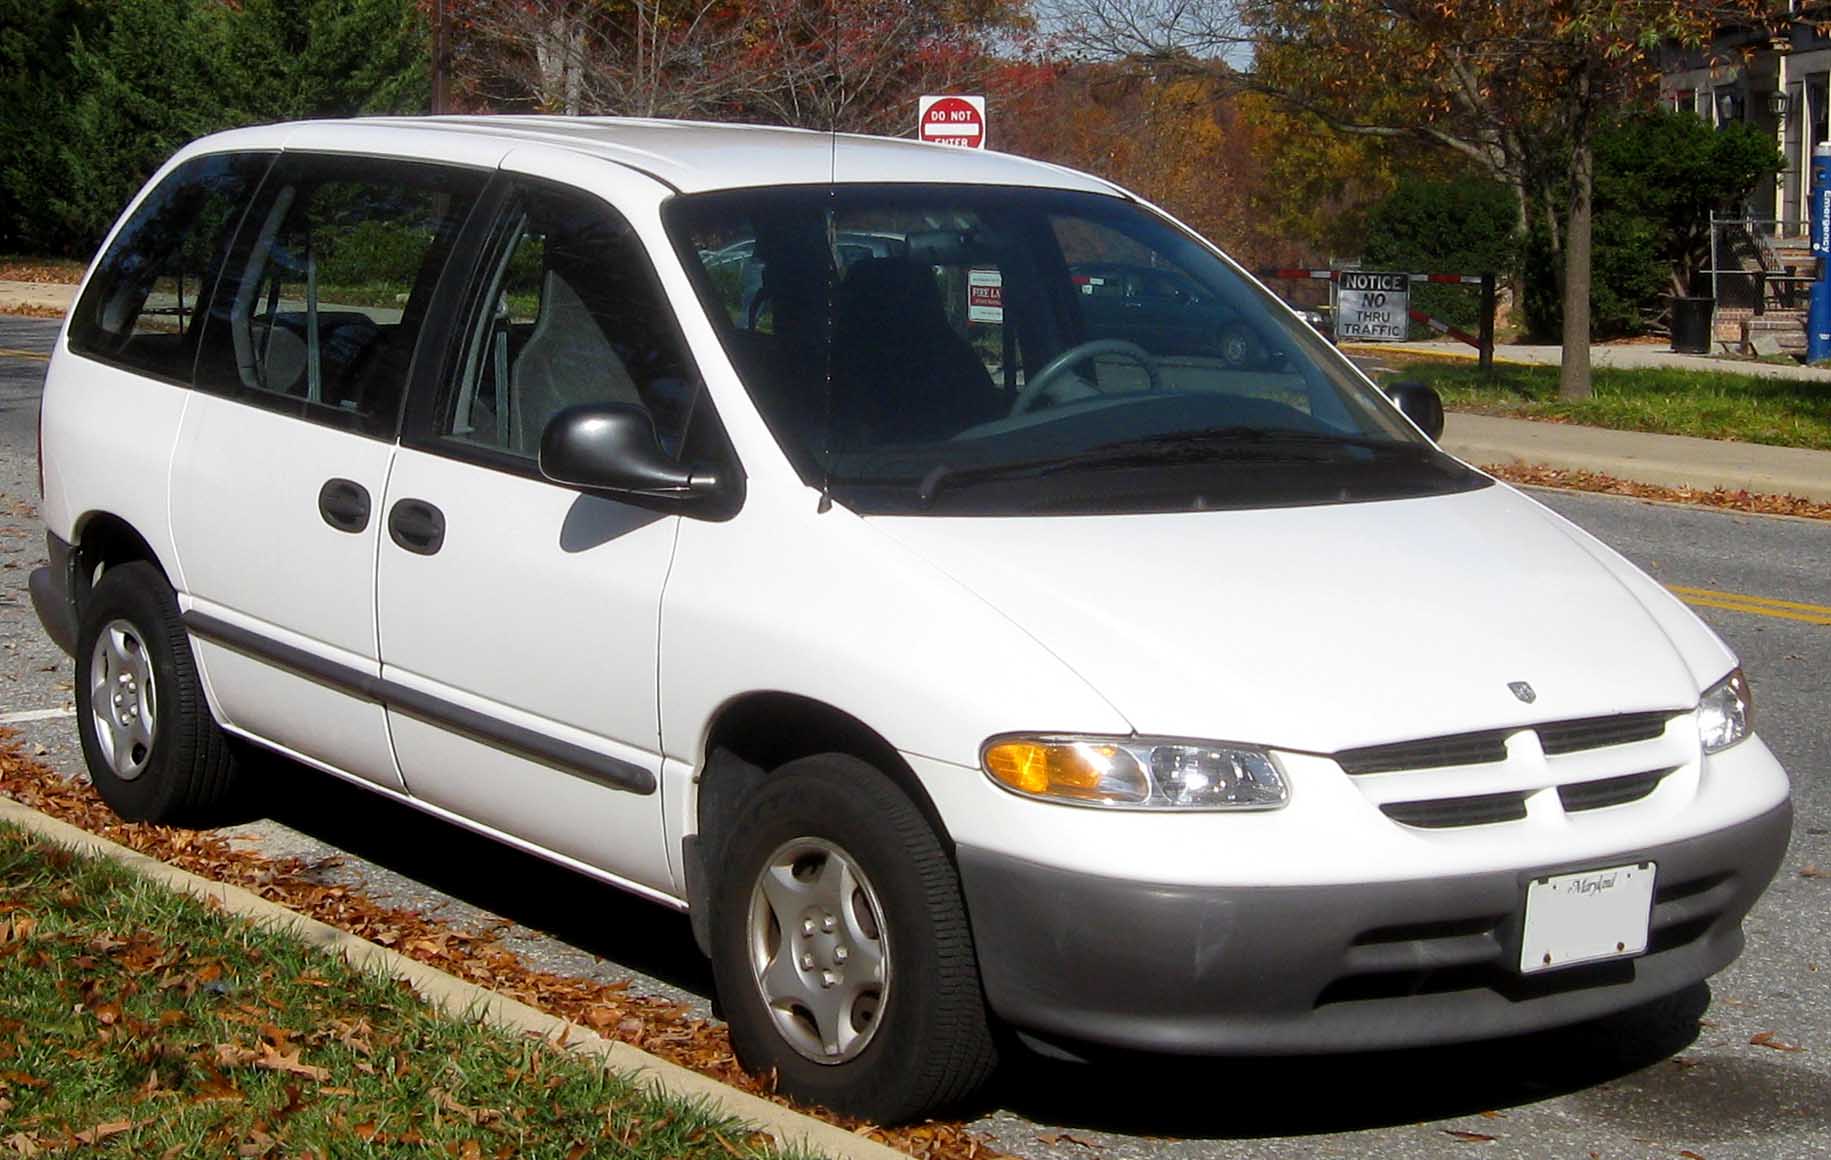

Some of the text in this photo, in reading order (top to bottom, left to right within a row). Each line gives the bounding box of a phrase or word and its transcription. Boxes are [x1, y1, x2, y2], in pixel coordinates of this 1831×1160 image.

[931, 111, 972, 121] DO NOT
[935, 138, 969, 149] ENTER
[1820, 190, 1831, 253] Emergency
[1345, 274, 1401, 290] NOTICE
[972, 287, 1001, 299] FIRE LA
[1361, 293, 1386, 308] NO
[1356, 310, 1391, 323] THRU
[1343, 322, 1401, 337] TRAFFIC
[1568, 871, 1618, 896] Maryland
